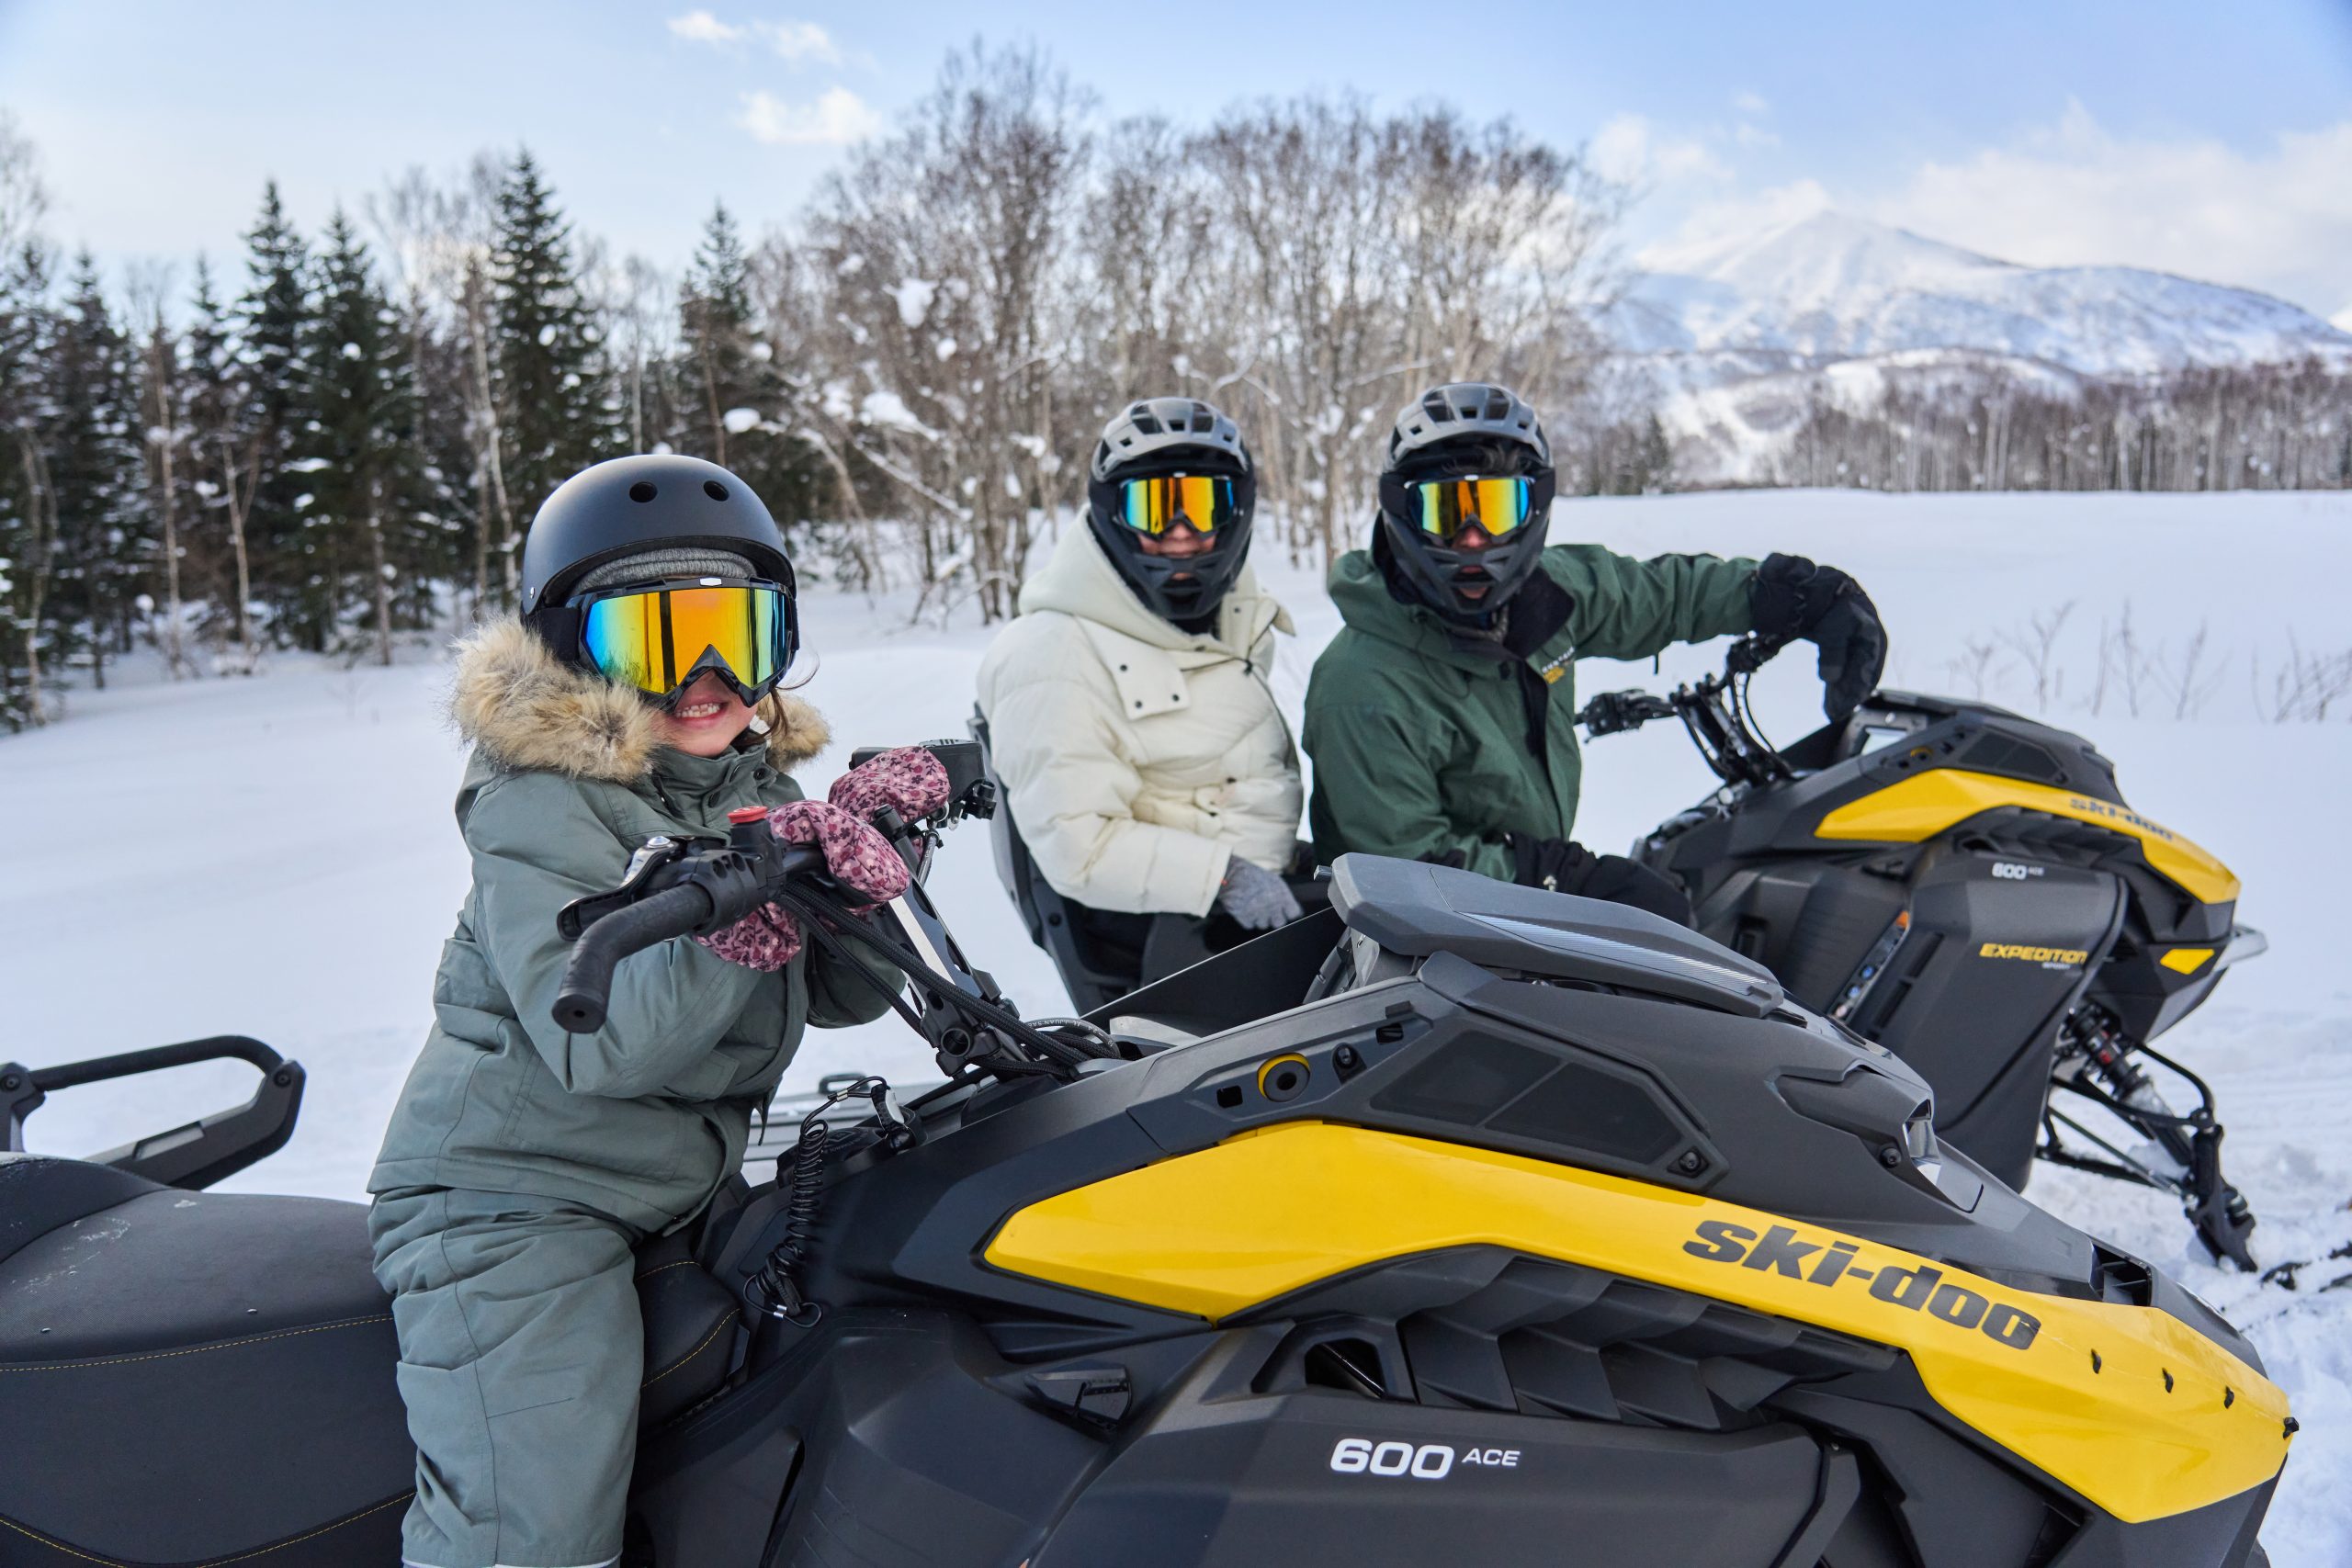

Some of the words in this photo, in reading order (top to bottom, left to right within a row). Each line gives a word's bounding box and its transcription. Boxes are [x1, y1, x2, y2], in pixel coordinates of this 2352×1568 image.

[1992, 863, 2027, 880] 600
[1979, 942, 2088, 964] EXPEDITION
[1682, 1219, 2041, 1350] ski-doo
[1330, 1438, 1454, 1479] 600
[1462, 1448, 1521, 1466] ACE
